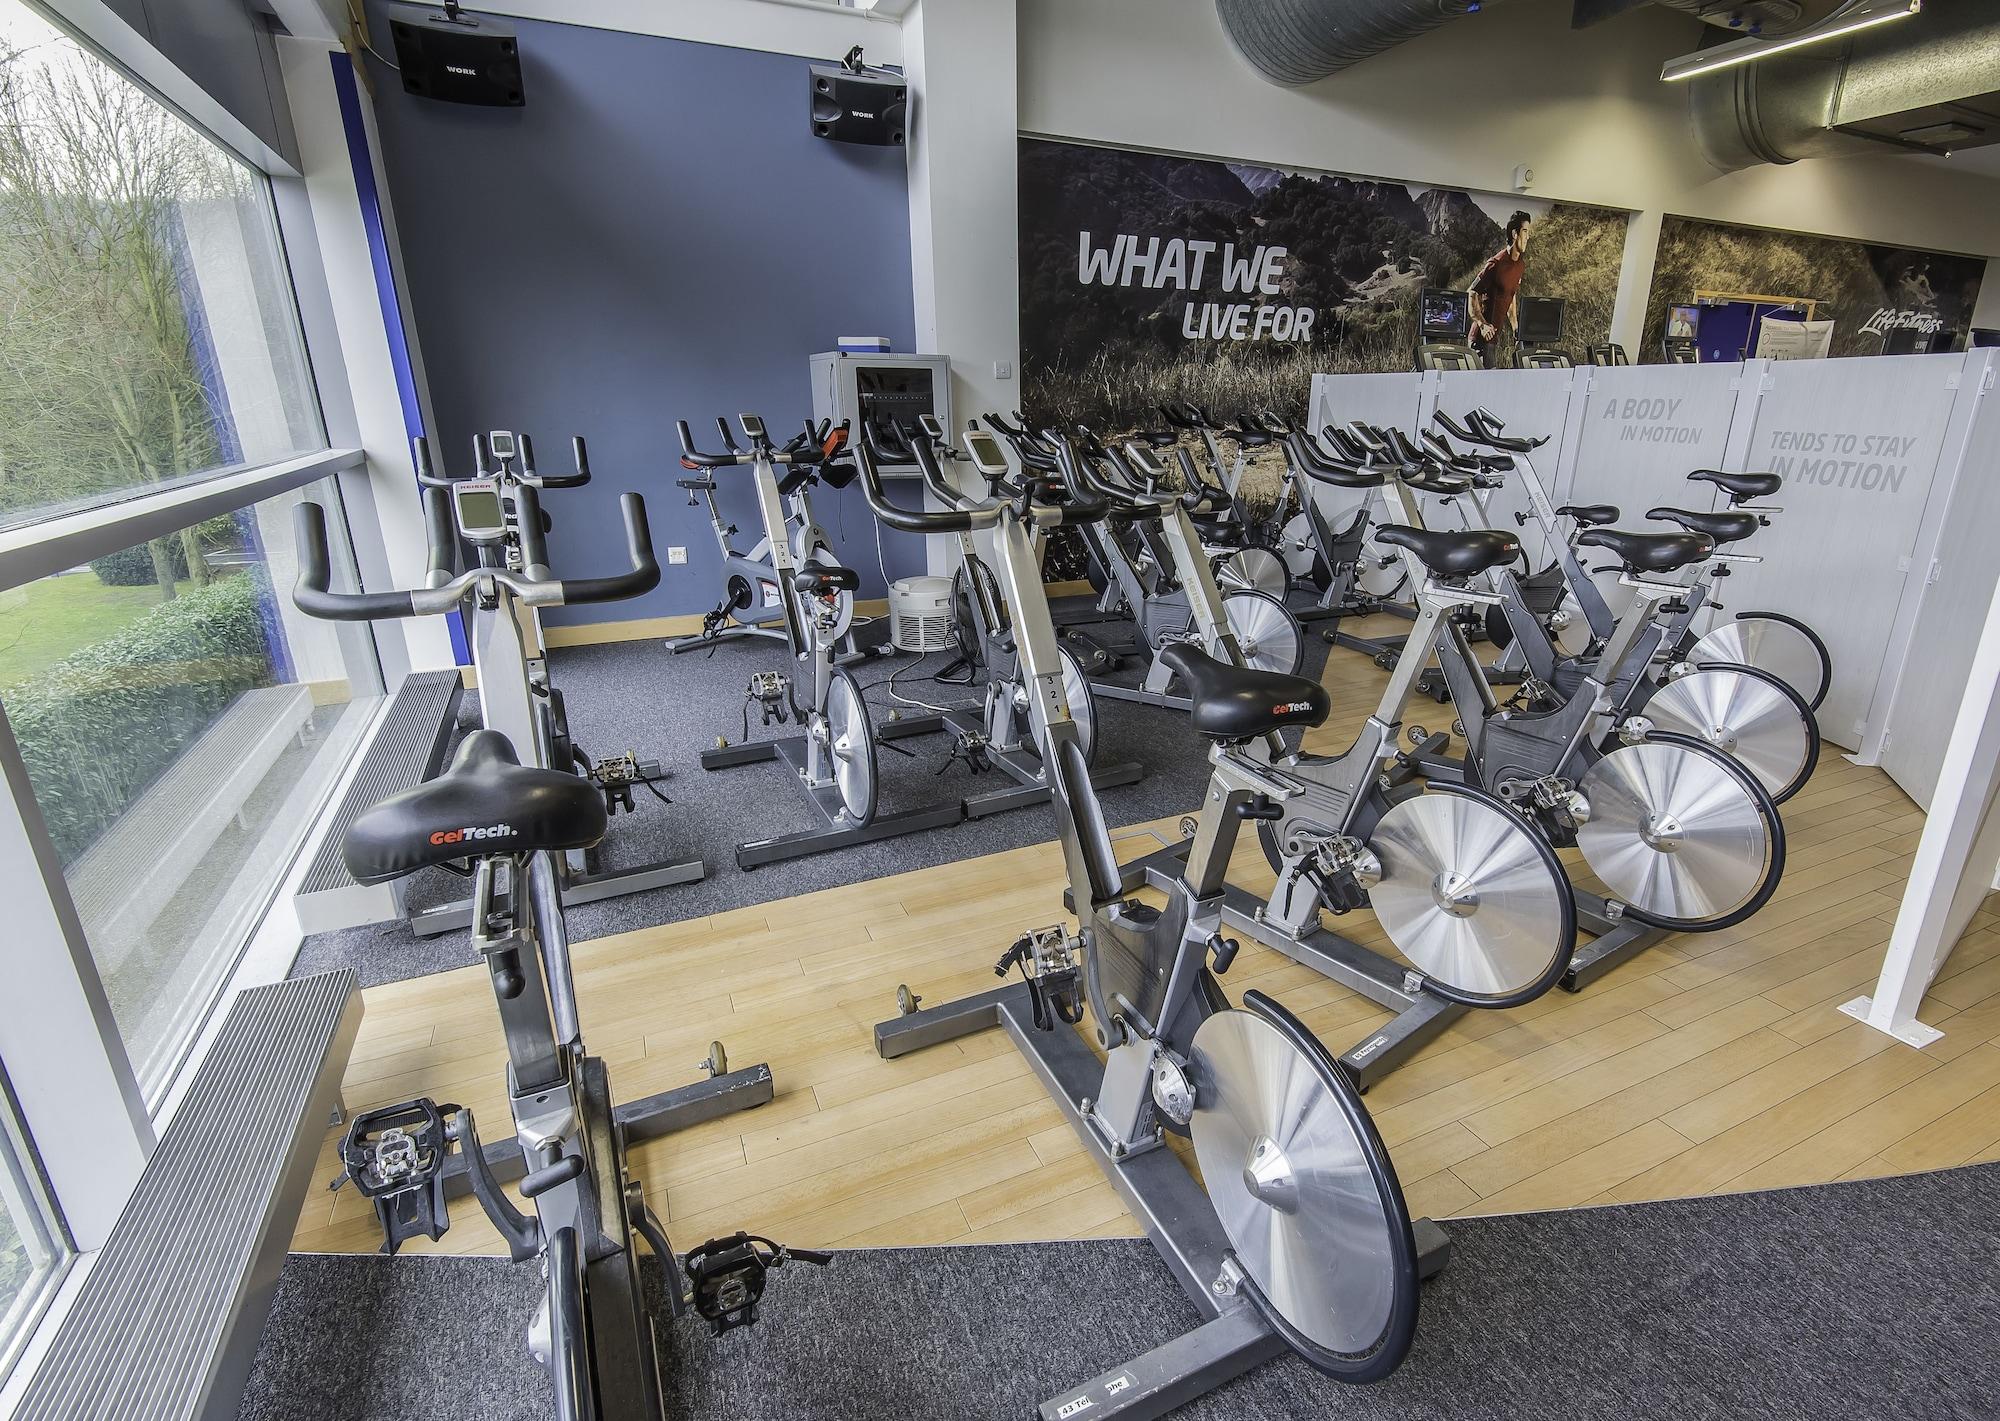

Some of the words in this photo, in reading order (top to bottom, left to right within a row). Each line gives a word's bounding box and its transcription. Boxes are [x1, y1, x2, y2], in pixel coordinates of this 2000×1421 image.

[446, 65, 476, 75] WORK
[852, 110, 874, 119] WORK
[1079, 231, 1217, 291] WHAT
[1222, 242, 1288, 295] WE
[1182, 302, 1250, 340] LIVE
[1253, 306, 1315, 342] FOR
[1602, 398, 1618, 419] A
[1621, 398, 1683, 421] BODY
[1620, 425, 1638, 441] IN
[1639, 425, 1703, 444] MOTION
[1771, 431, 1828, 452] TENDS
[1832, 433, 1858, 455] TO
[1860, 435, 1918, 458] STAY
[1768, 455, 1795, 482] IN
[1796, 457, 1908, 493] MOTION
[1047, 676, 1054, 685] 3
[1050, 690, 1057, 699] 2
[1054, 704, 1060, 713] 1
[1062, 1404, 1074, 1416] 43
